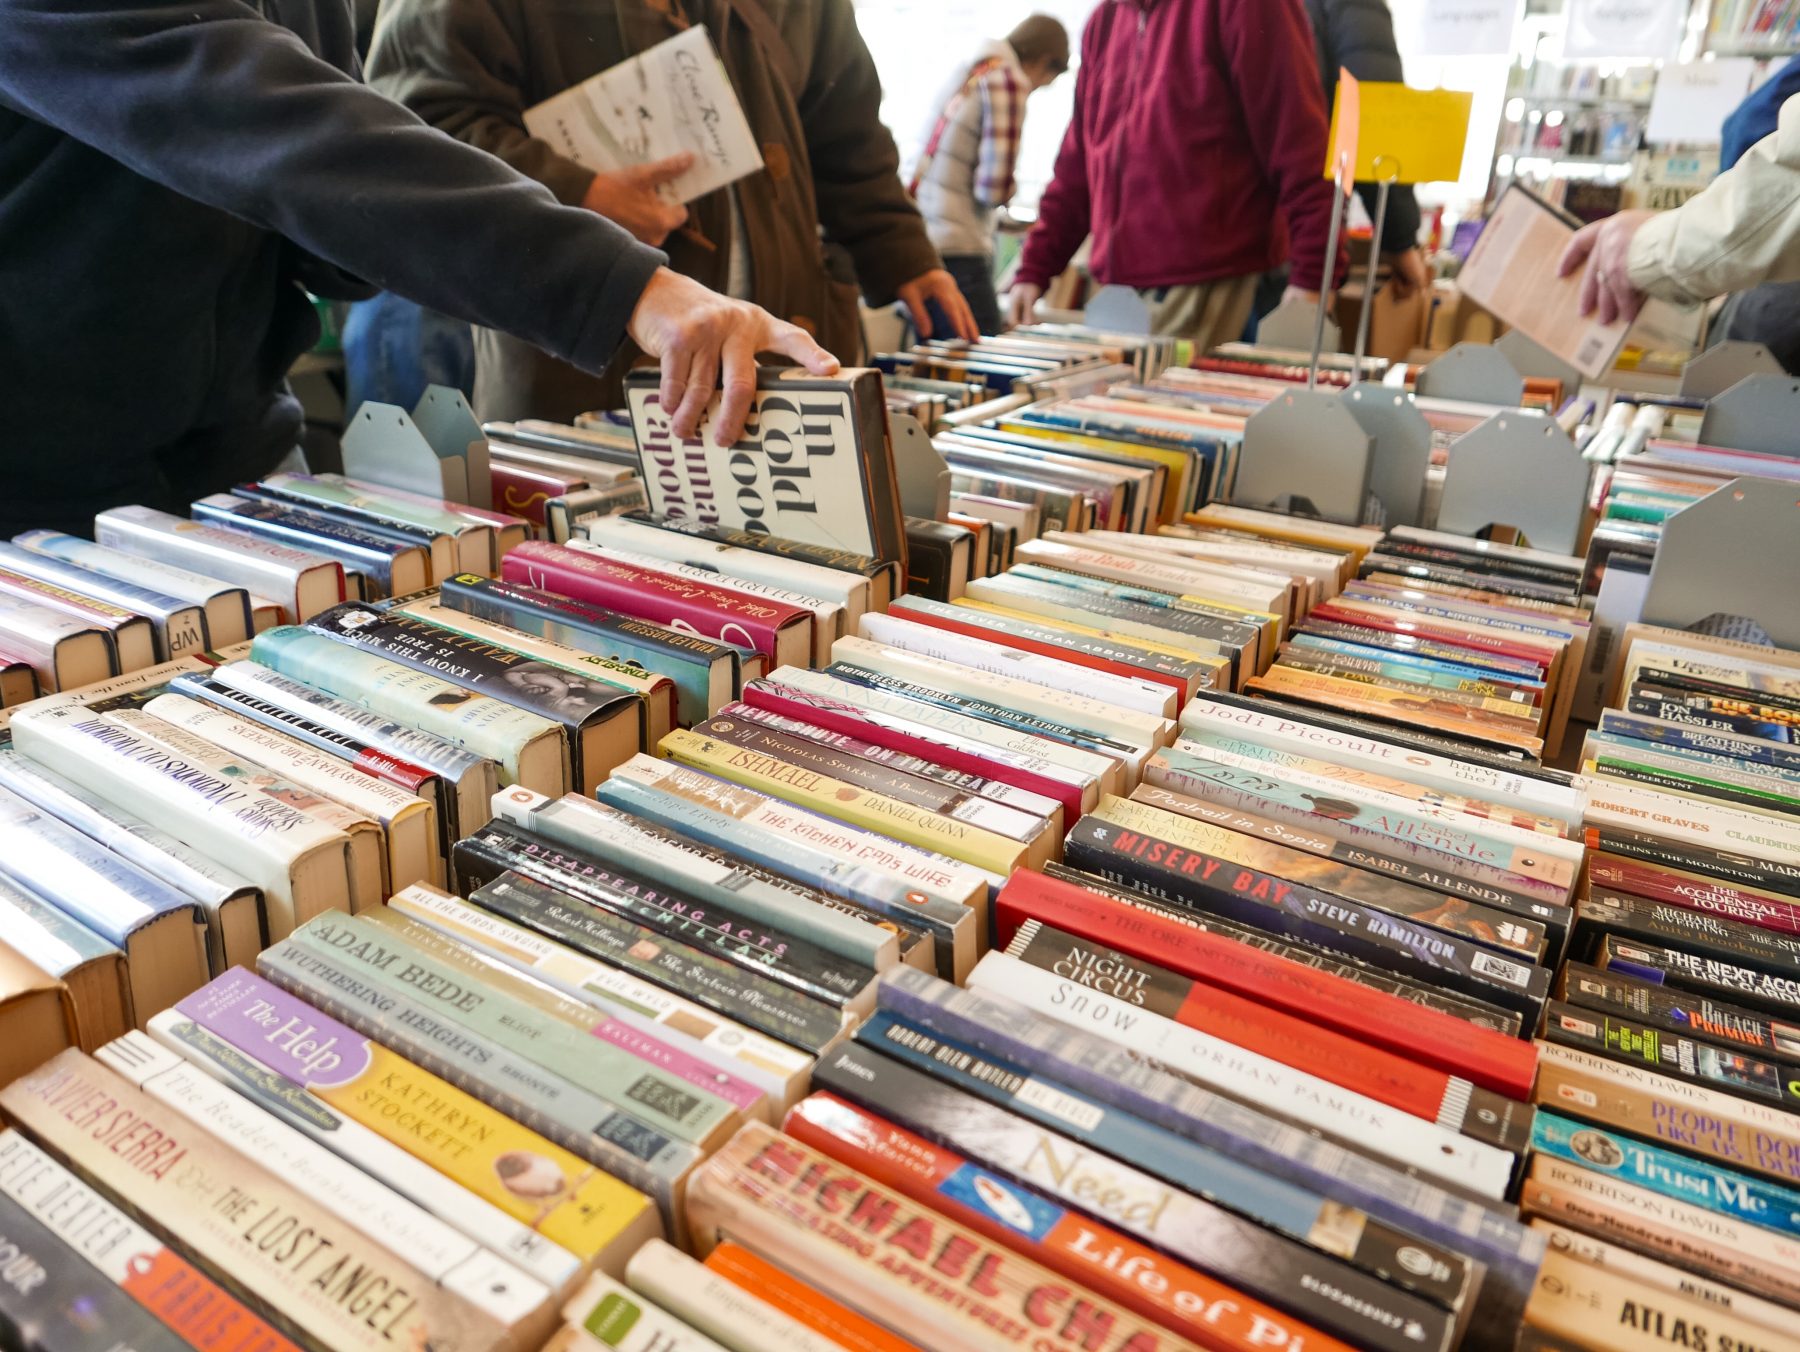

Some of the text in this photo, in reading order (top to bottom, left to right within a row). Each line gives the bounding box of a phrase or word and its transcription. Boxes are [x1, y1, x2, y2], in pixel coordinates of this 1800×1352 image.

[800, 397, 846, 456] In
[760, 395, 818, 515] Cold
[341, 626, 384, 648] MUCH
[384, 640, 423, 662] THIS
[393, 632, 433, 653] TRUE
[926, 603, 1147, 665] THE FEVER MEGAN ABBOTT
[421, 654, 473, 682] KNOW
[1343, 671, 1393, 687] DAVID
[1394, 682, 1474, 704] BALDACCI
[835, 663, 1071, 736] MOTHERLESS BROOKLYN JONATHAN LETHEM
[1659, 709, 1737, 734] HASSLER
[1660, 701, 1691, 715] JON
[730, 702, 785, 728] NEVIL
[787, 721, 853, 749] SHUTE
[863, 744, 893, 762] ON
[898, 753, 941, 777] THE
[1199, 702, 1394, 760] Jodi Picoult
[1681, 730, 1763, 755] BREATHING
[759, 735, 826, 763] NICHOLAS
[826, 757, 880, 781] SPARKS
[1454, 770, 1486, 783] the
[1598, 764, 1628, 777] IBSEN
[1636, 772, 1661, 785] PEER
[1662, 777, 1695, 791] GYNT
[726, 750, 823, 793] ISHMAEL
[861, 796, 915, 824] DANIEL
[916, 814, 970, 841] QUINN
[1589, 798, 1650, 822] ROBERT
[1651, 812, 1711, 834] GRAVES
[1102, 809, 1134, 826] THE
[1136, 818, 1207, 850] INFINITE
[1111, 798, 1235, 846] ISABEL ALLENDE
[1366, 814, 1497, 860] Allende
[1419, 821, 1469, 844] Isabel
[758, 809, 789, 830] THE
[790, 818, 860, 853] KITCHEN
[902, 862, 954, 889] WIFE
[1146, 788, 1514, 906] Portrait in Sepia ISABEL ALLENDE
[1602, 838, 1766, 883] COLLINS THE MOONSTONE
[411, 891, 434, 907] ALL
[434, 900, 459, 919] THE
[524, 843, 706, 922] DISAPPEARING
[716, 920, 790, 957] ACTS
[1112, 829, 1222, 881] MISERY
[1231, 870, 1293, 905] BAY
[1306, 898, 1360, 928] STEVE
[1366, 917, 1458, 961] HAMILTON
[1673, 884, 1781, 917] ACCIDENTAL
[1690, 896, 1766, 922] TOURIST
[1710, 884, 1739, 898] THE
[1647, 920, 1692, 939] Anita
[1656, 905, 1723, 929] MICHAEL
[1749, 932, 1773, 946] THE
[309, 919, 402, 973] ADAM
[394, 962, 487, 1017] BEDE
[657, 952, 683, 973] The
[686, 965, 737, 998] Sixteen
[1052, 958, 1149, 1008] CIRCUS
[1066, 946, 1153, 989] NIGHT
[1664, 948, 1758, 986] THE NEXT
[1690, 969, 1736, 987] LISA
[279, 944, 495, 1067] WUTHERING HEIGHTS
[1701, 999, 1762, 1036] BREACH
[242, 997, 281, 1030] The
[263, 1015, 345, 1077] Help
[165, 1071, 204, 1106] The
[1191, 1042, 1282, 1088] ORHAN
[1293, 1085, 1387, 1130] PAMUK
[1544, 1045, 1710, 1101] ROBERTSON DAVIES
[354, 1087, 476, 1161] STOCKETT
[379, 1070, 498, 1146] KATHRYN
[1651, 1100, 1736, 1143] PEOPLE
[92, 1107, 188, 1183] SIERRA
[1023, 1131, 1172, 1233] Need
[1626, 1145, 1769, 1215] Trust Me
[35, 1179, 134, 1261] DEXTER
[745, 1139, 1005, 1300] MICHAEL
[1551, 1166, 1740, 1242] ROBERTSON DAVIES
[1565, 1201, 1595, 1221] One
[1597, 1209, 1675, 1250] Hundred
[211, 1185, 421, 1343] THE LOST ANGEL
[1066, 1227, 1306, 1352] Life of Pi
[1619, 1298, 1710, 1351] ATLAS
